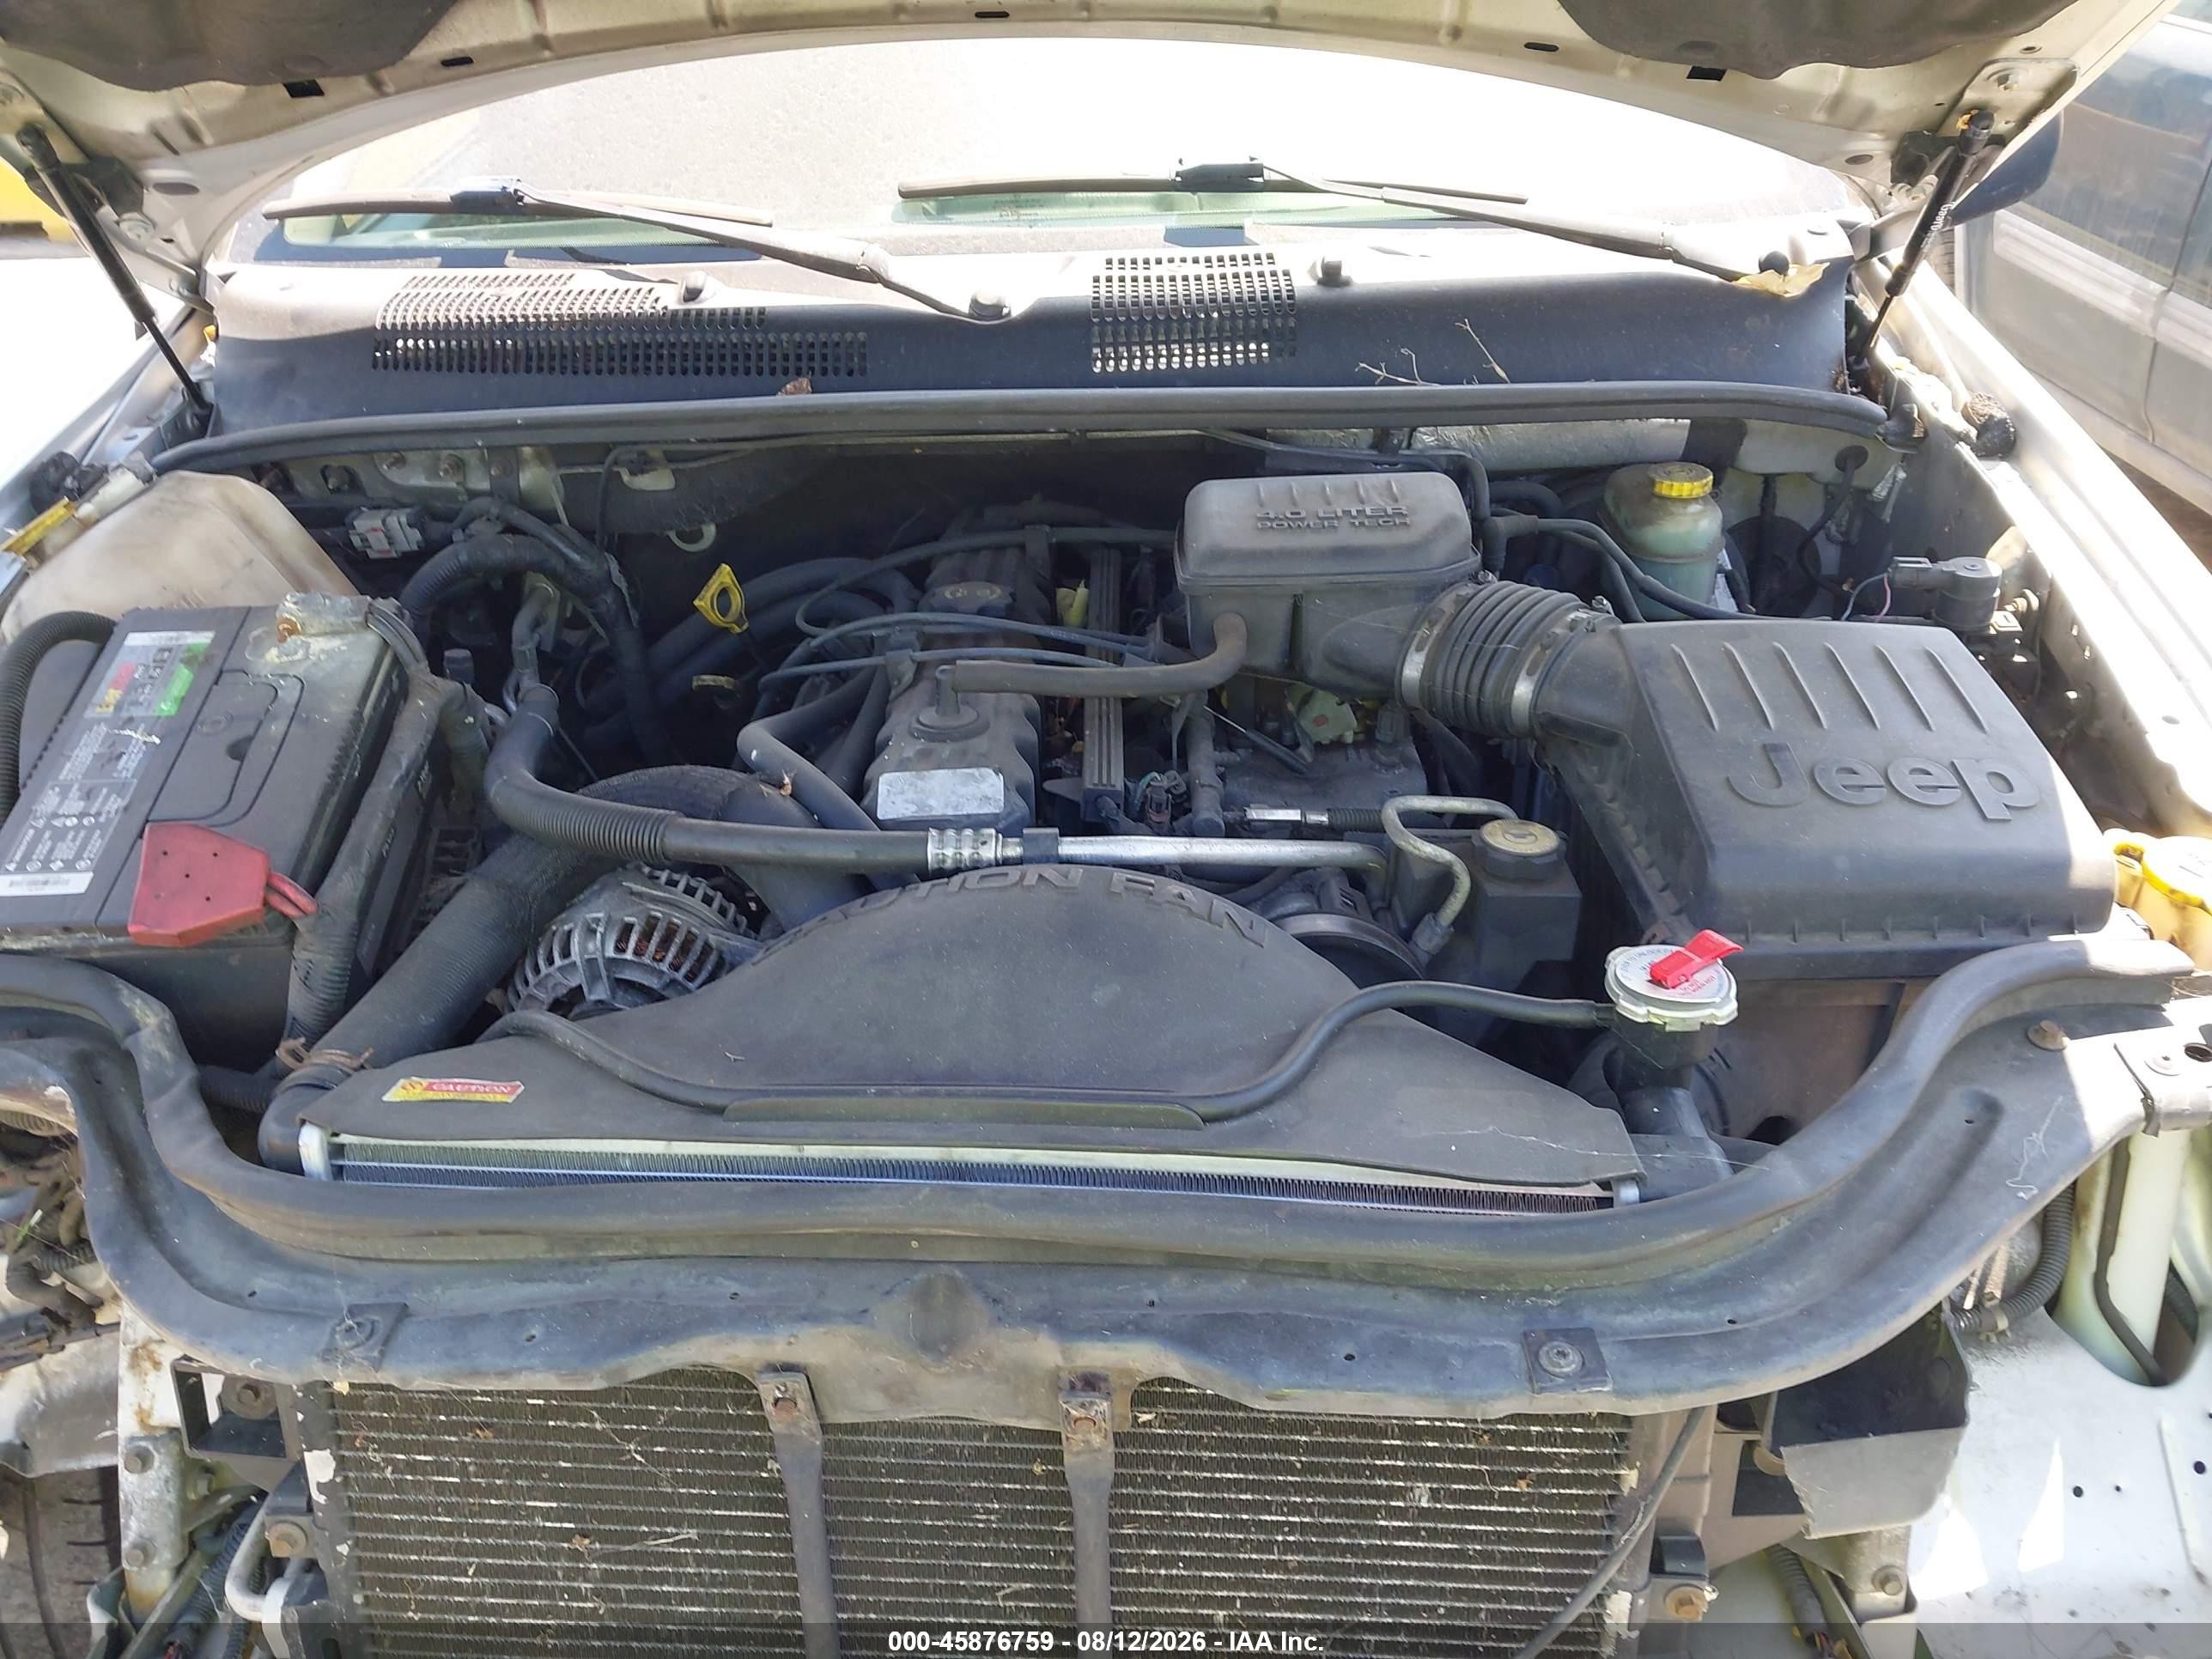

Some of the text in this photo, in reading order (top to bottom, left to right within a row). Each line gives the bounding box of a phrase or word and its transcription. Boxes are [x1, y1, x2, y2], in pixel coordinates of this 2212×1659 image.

[1255, 506, 1409, 520] 4.0 LITER
[1256, 517, 1411, 530] POWER TECH
[1727, 742, 2041, 822] Jeep
[1110, 872, 1267, 948] FAN
[432, 1081, 512, 1094] CAUTION
